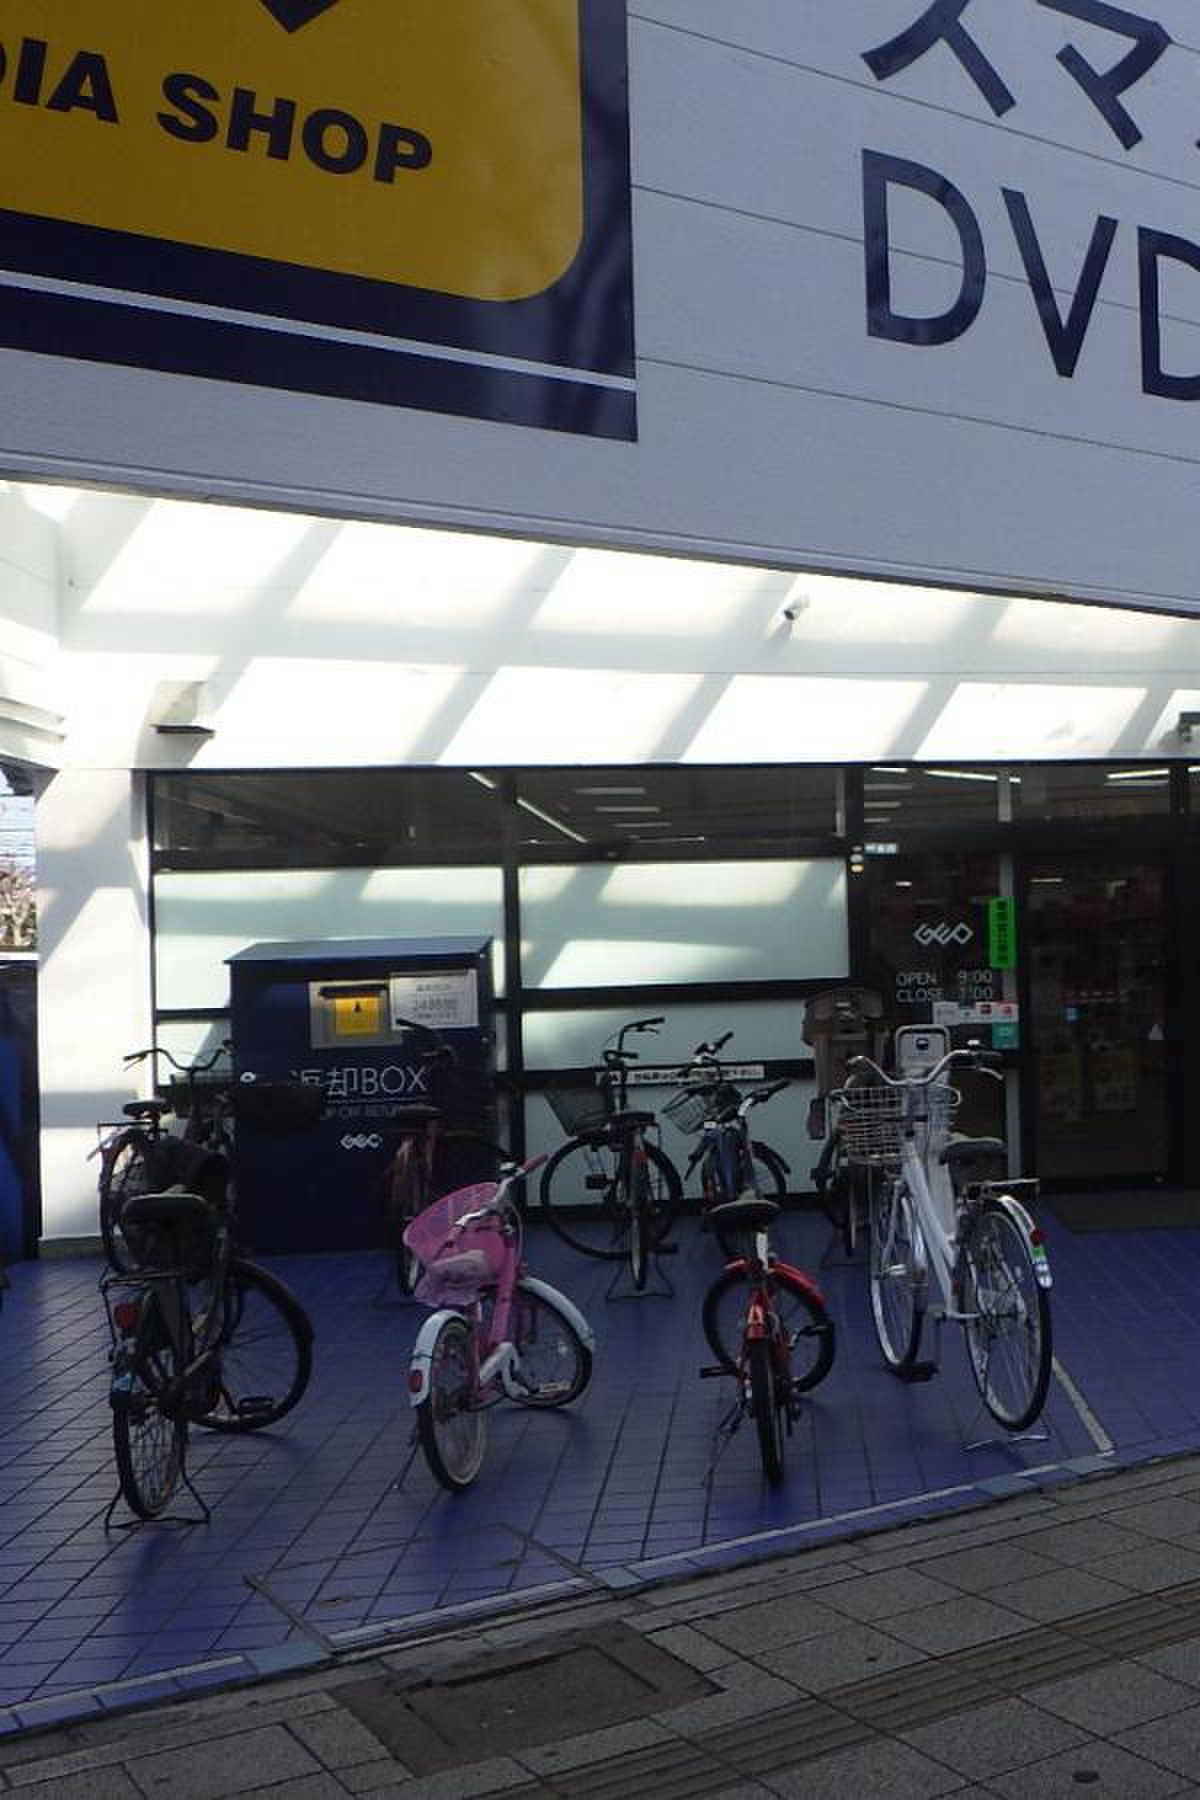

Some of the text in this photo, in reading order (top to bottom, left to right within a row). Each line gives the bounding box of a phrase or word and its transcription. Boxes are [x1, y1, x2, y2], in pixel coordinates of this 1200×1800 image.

[0, 37, 433, 185] IA SHOP
[913, 922, 974, 945] GEO
[896, 971, 937, 986] OPEN
